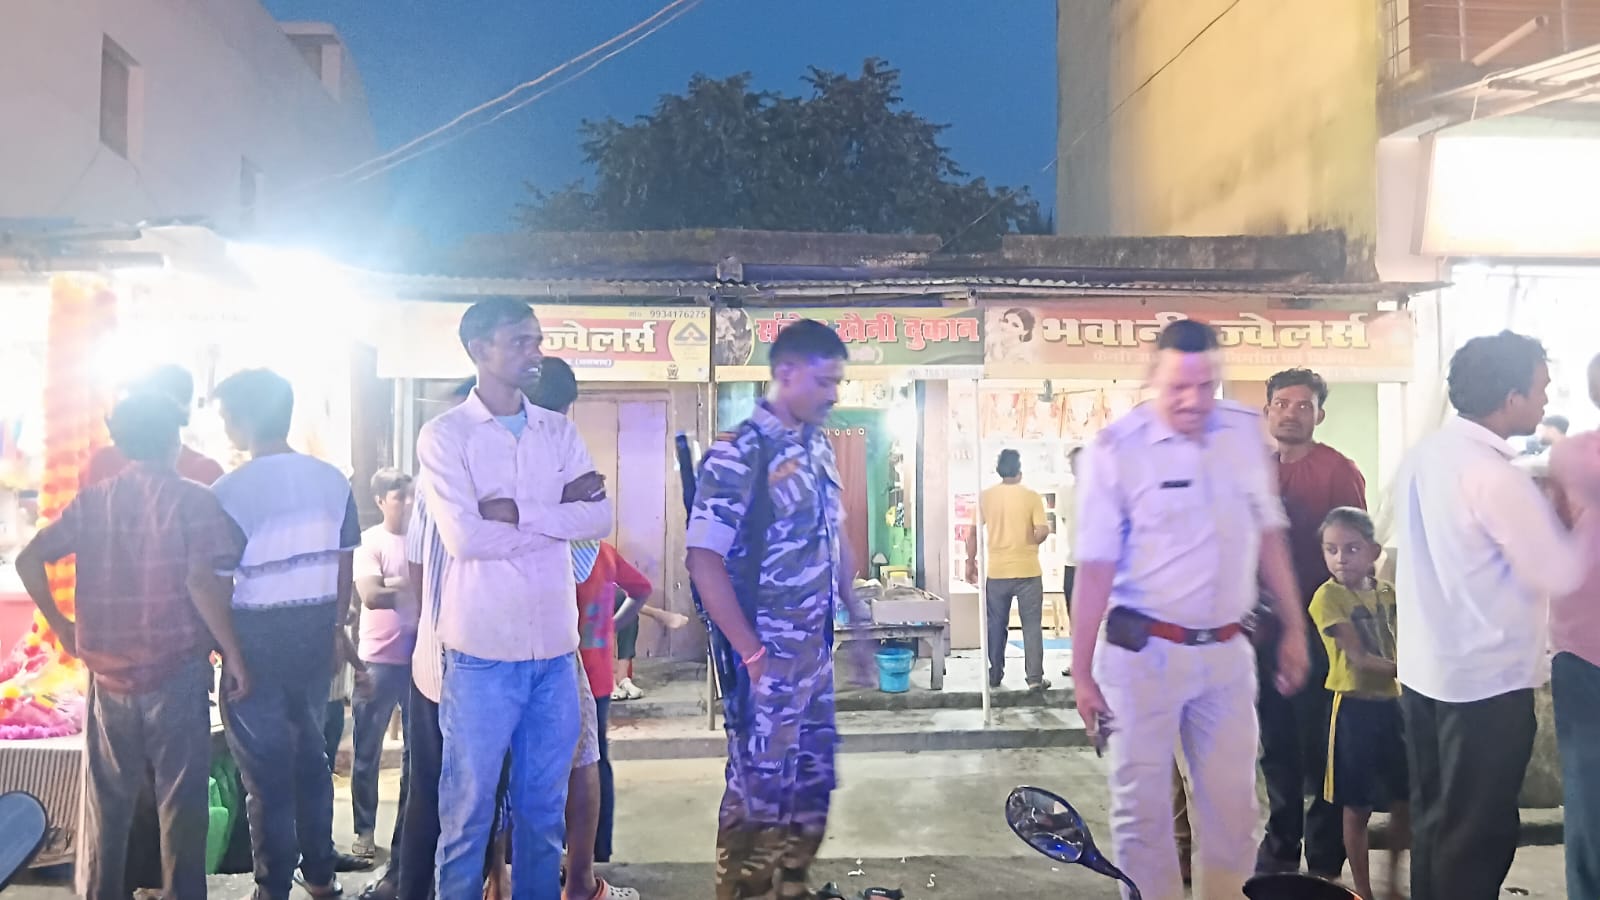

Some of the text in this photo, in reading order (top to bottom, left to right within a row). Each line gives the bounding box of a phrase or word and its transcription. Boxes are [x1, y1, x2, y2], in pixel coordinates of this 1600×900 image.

[649, 310, 706, 319] 9934176275
[1209, 312, 1370, 349] ज्वेलर्स
[540, 319, 657, 353] ज्वेलर्स
[903, 317, 980, 351] दुकान
